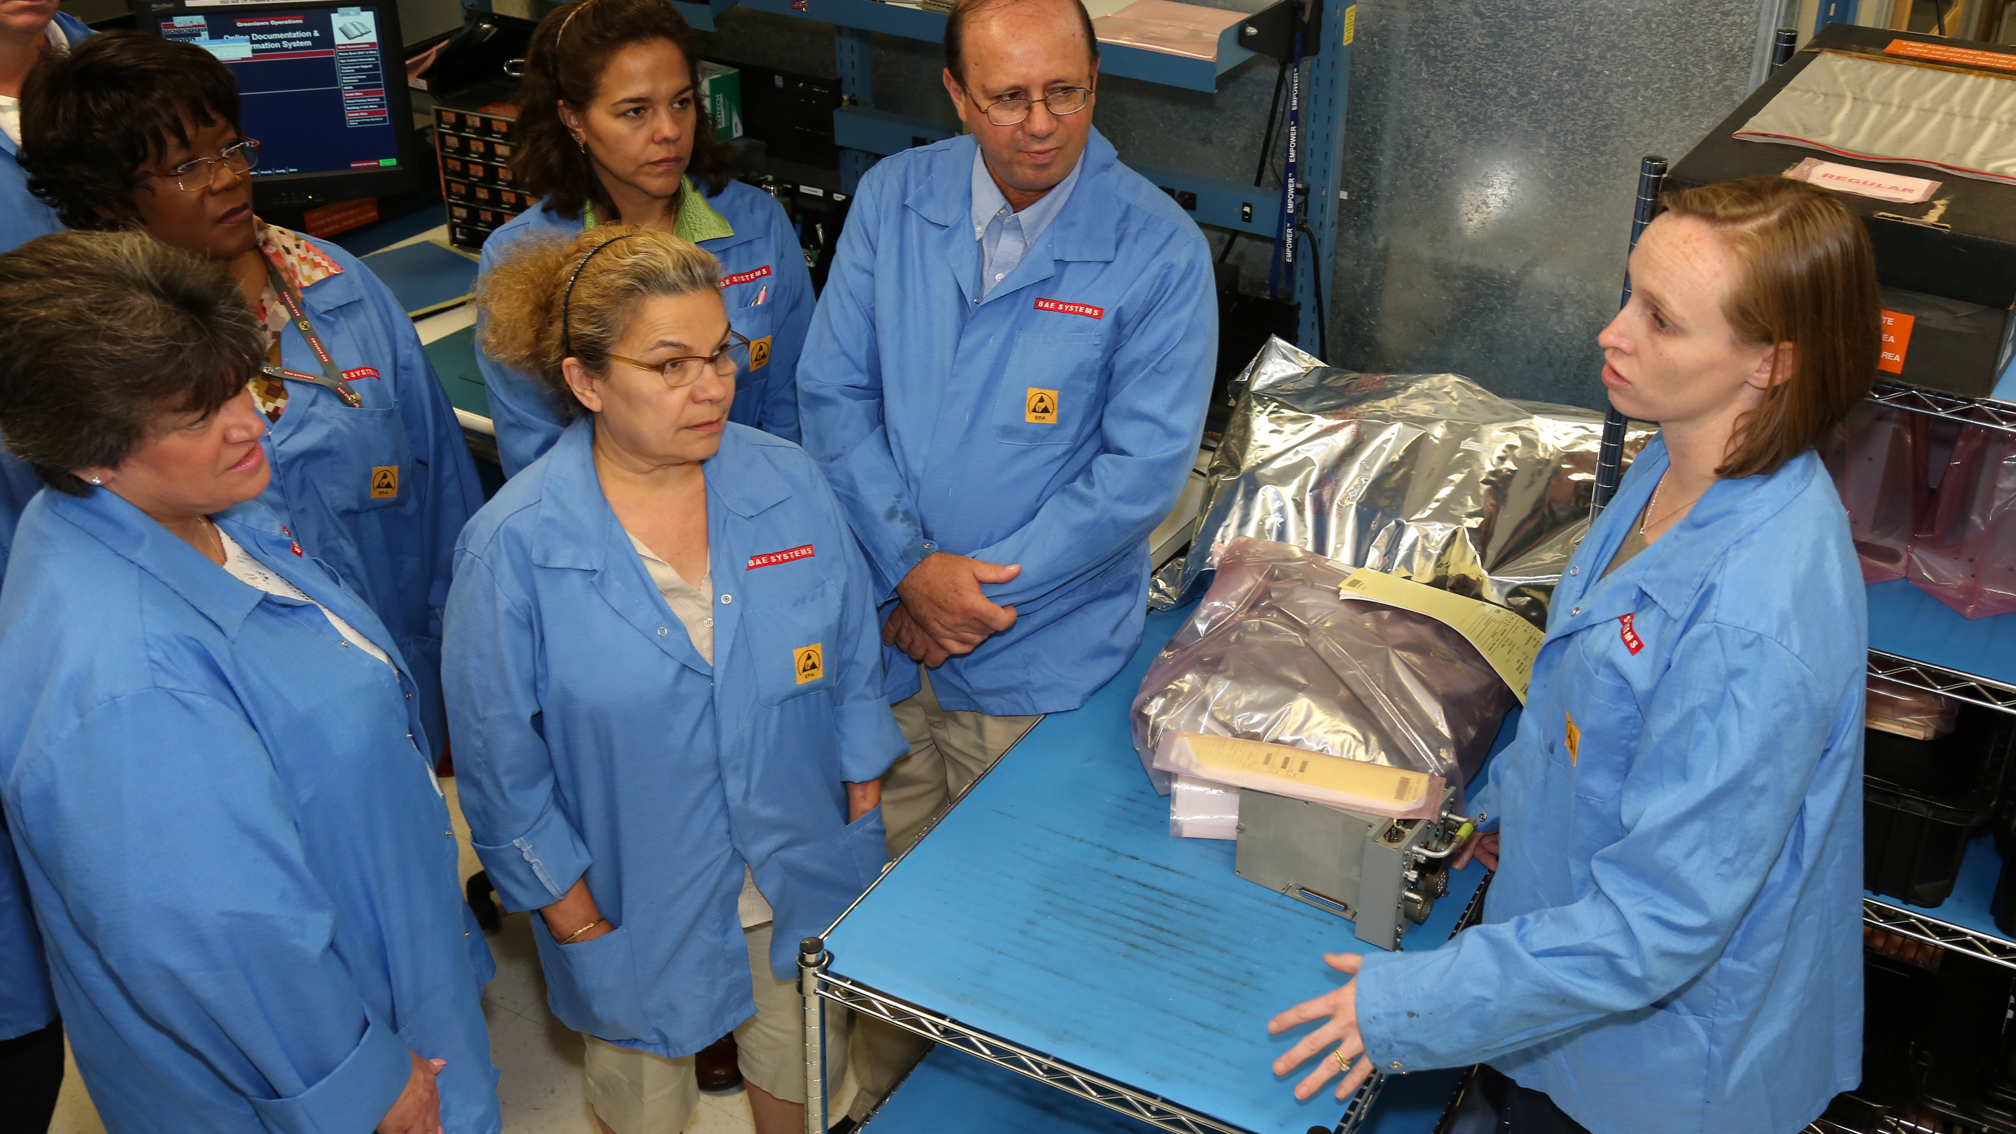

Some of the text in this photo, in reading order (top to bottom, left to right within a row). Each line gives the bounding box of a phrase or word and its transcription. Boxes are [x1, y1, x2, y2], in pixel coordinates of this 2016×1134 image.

[270, 18, 304, 26] Operations
[251, 30, 312, 41] Documentation
[313, 30, 320, 38] &
[250, 40, 313, 51] rmation System
[1822, 172, 1916, 194] REGULAR
[732, 268, 768, 283] SYSTEMS
[1038, 301, 1100, 316] BAE SYSTEMS
[1882, 316, 1894, 326] TE
[1881, 334, 1895, 343] EA
[1881, 351, 1901, 362] REA
[748, 546, 813, 567] BAE SYSTEMS
